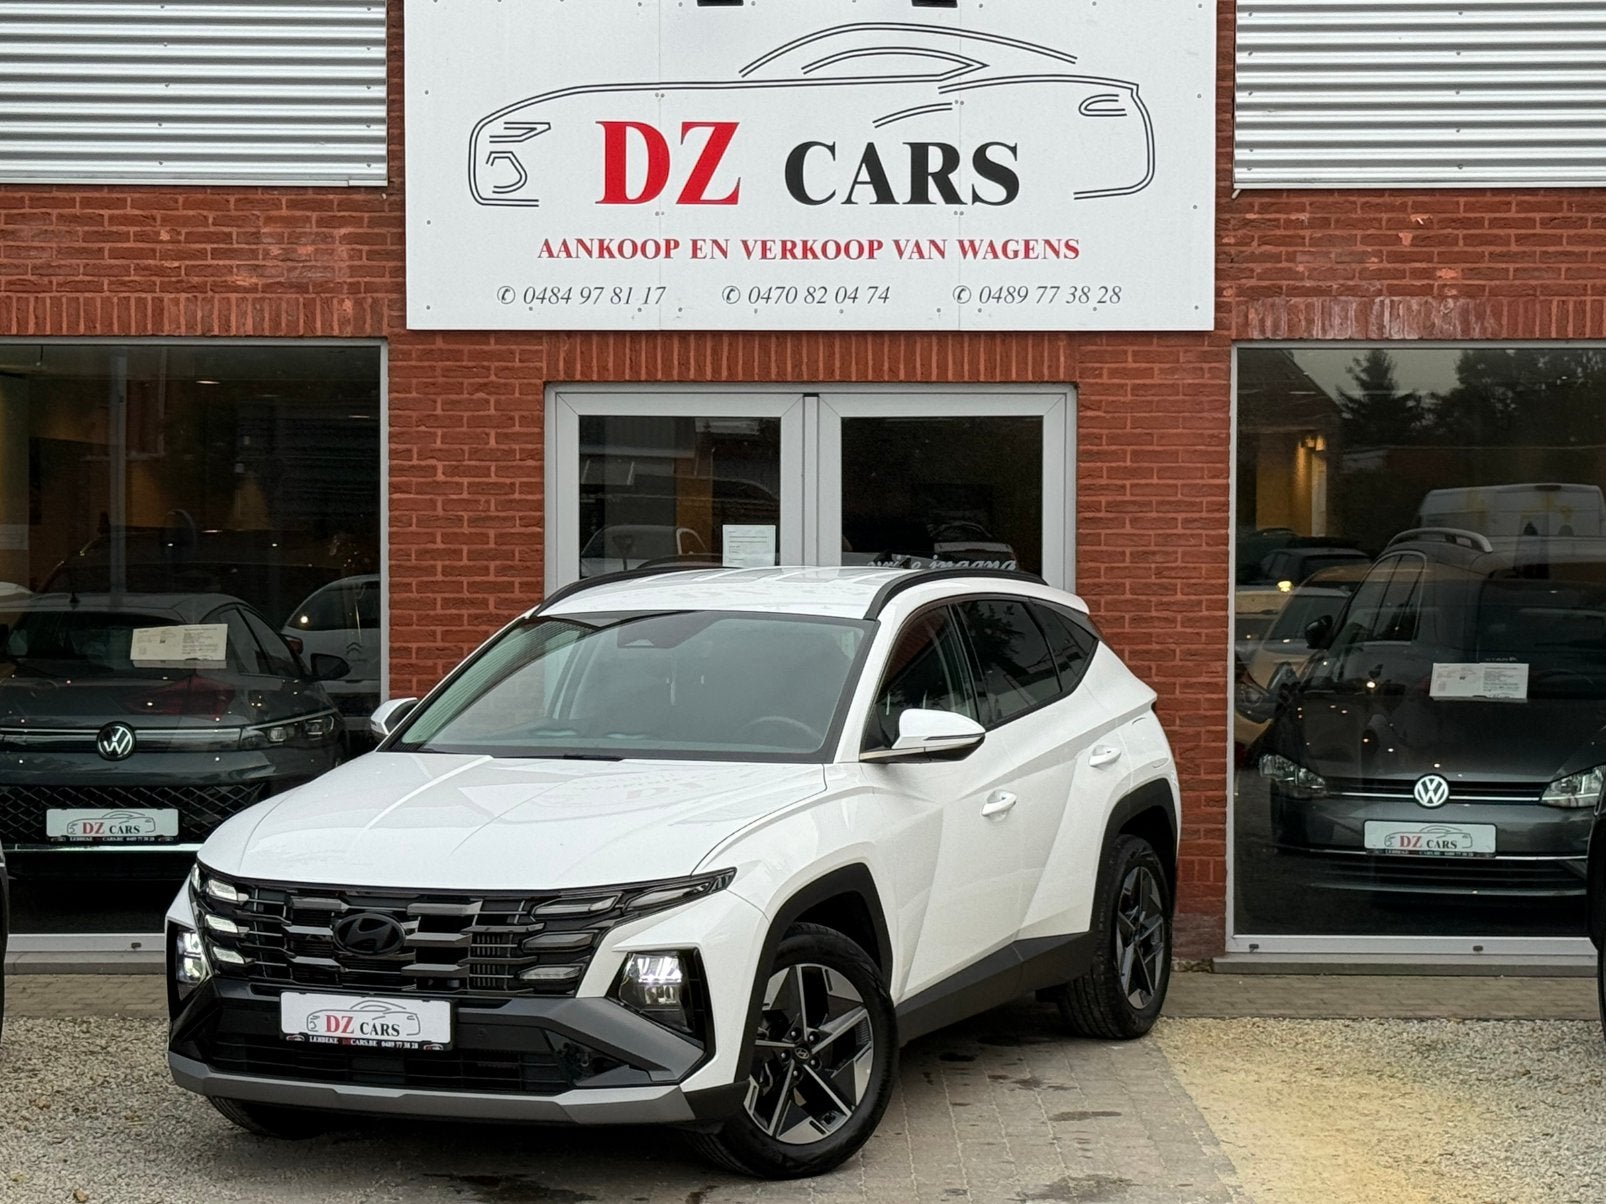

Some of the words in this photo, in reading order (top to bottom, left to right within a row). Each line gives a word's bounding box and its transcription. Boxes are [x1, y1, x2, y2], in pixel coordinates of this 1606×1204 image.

[596, 121, 740, 205] DZ
[785, 141, 1019, 206] CARS
[538, 238, 680, 260] AANKOOP
[690, 238, 728, 260] EN
[741, 238, 884, 260] VERKOOP
[893, 238, 947, 260] VAN
[957, 238, 1080, 260] WAGENS
[523, 286, 574, 305] 0484
[580, 286, 605, 305] 97
[610, 286, 633, 305] 81
[642, 286, 667, 305] 17
[748, 286, 798, 305] 0470
[804, 286, 828, 305] 82
[835, 286, 859, 305] 04
[866, 286, 891, 305] 74
[979, 286, 1029, 305] 0489
[1036, 286, 1060, 305] 77
[1065, 286, 1091, 305] 38
[1097, 286, 1122, 305] 28
[82, 822, 105, 835] DZ
[109, 825, 141, 834] CARS
[1399, 835, 1422, 849] DZ
[1426, 839, 1458, 850] CARS
[325, 1014, 355, 1034] DZ
[359, 1021, 400, 1037] CARS
